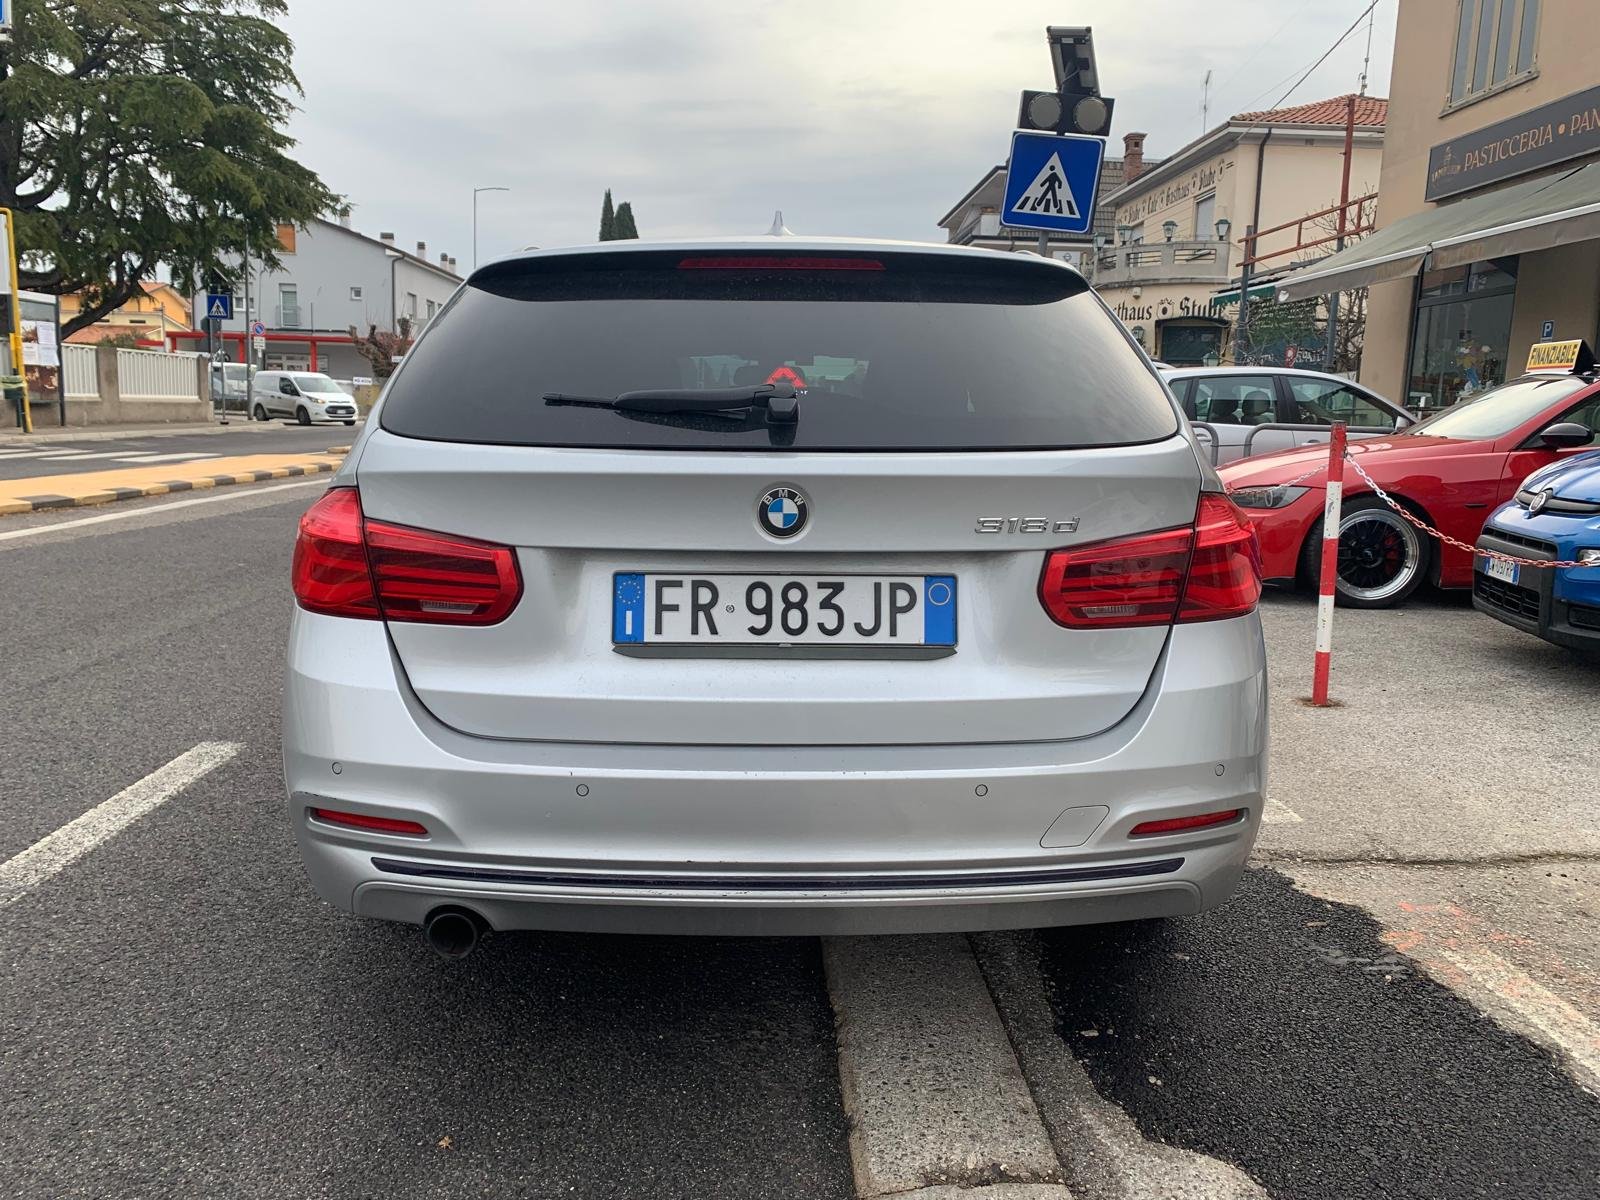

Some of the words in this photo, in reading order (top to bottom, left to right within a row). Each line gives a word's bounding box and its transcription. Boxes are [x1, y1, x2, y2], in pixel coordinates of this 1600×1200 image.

[1464, 124, 1553, 172] PASTICCERIA
[1544, 323, 1552, 336] P
[1530, 344, 1579, 365] FINANZIABILE
[762, 489, 804, 506] BMW
[975, 517, 1080, 533] 318d
[654, 580, 719, 635] FR
